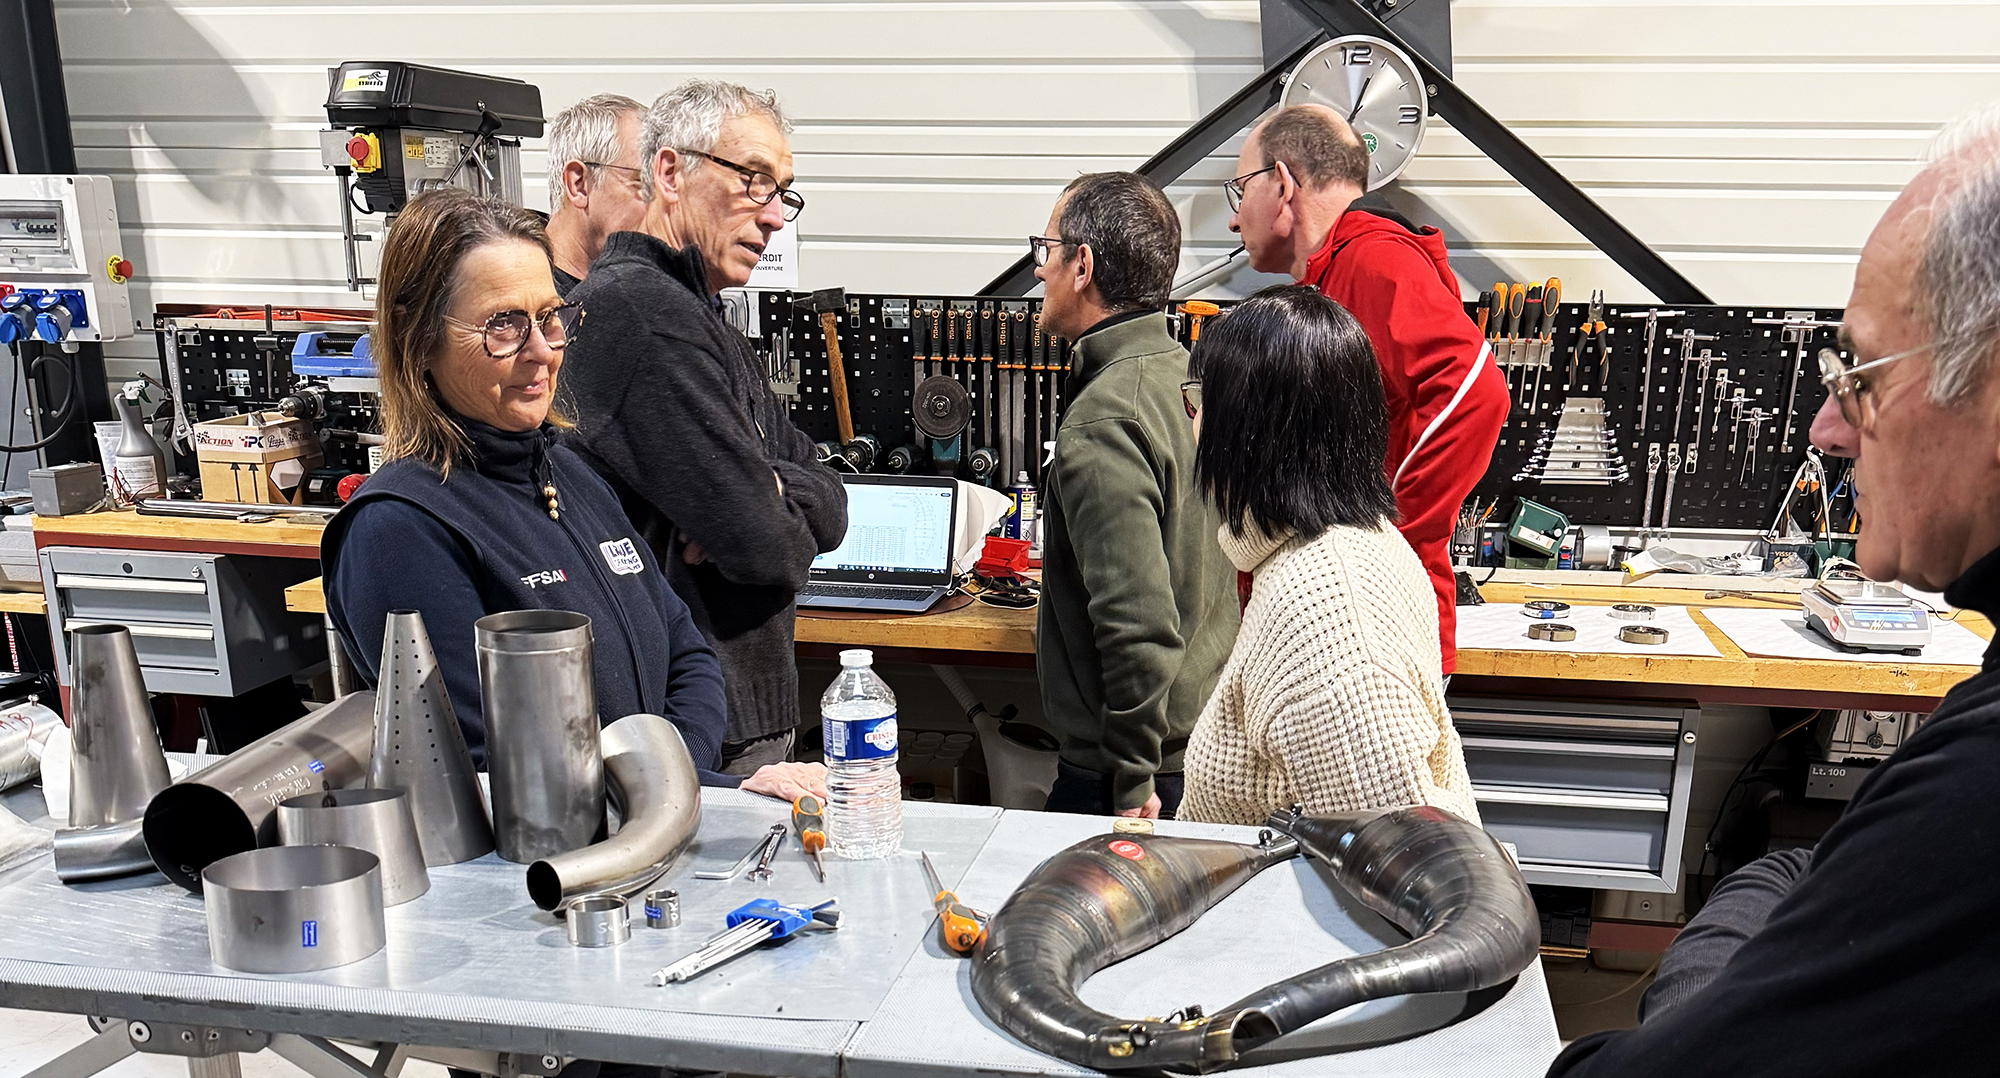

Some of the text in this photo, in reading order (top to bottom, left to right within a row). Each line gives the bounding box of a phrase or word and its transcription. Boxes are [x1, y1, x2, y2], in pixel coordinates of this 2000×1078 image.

[1341, 46, 1372, 66] 12
[1398, 104, 1420, 126] 3
[758, 253, 783, 262] RDIT
[1812, 767, 1846, 777] Lt. 100
